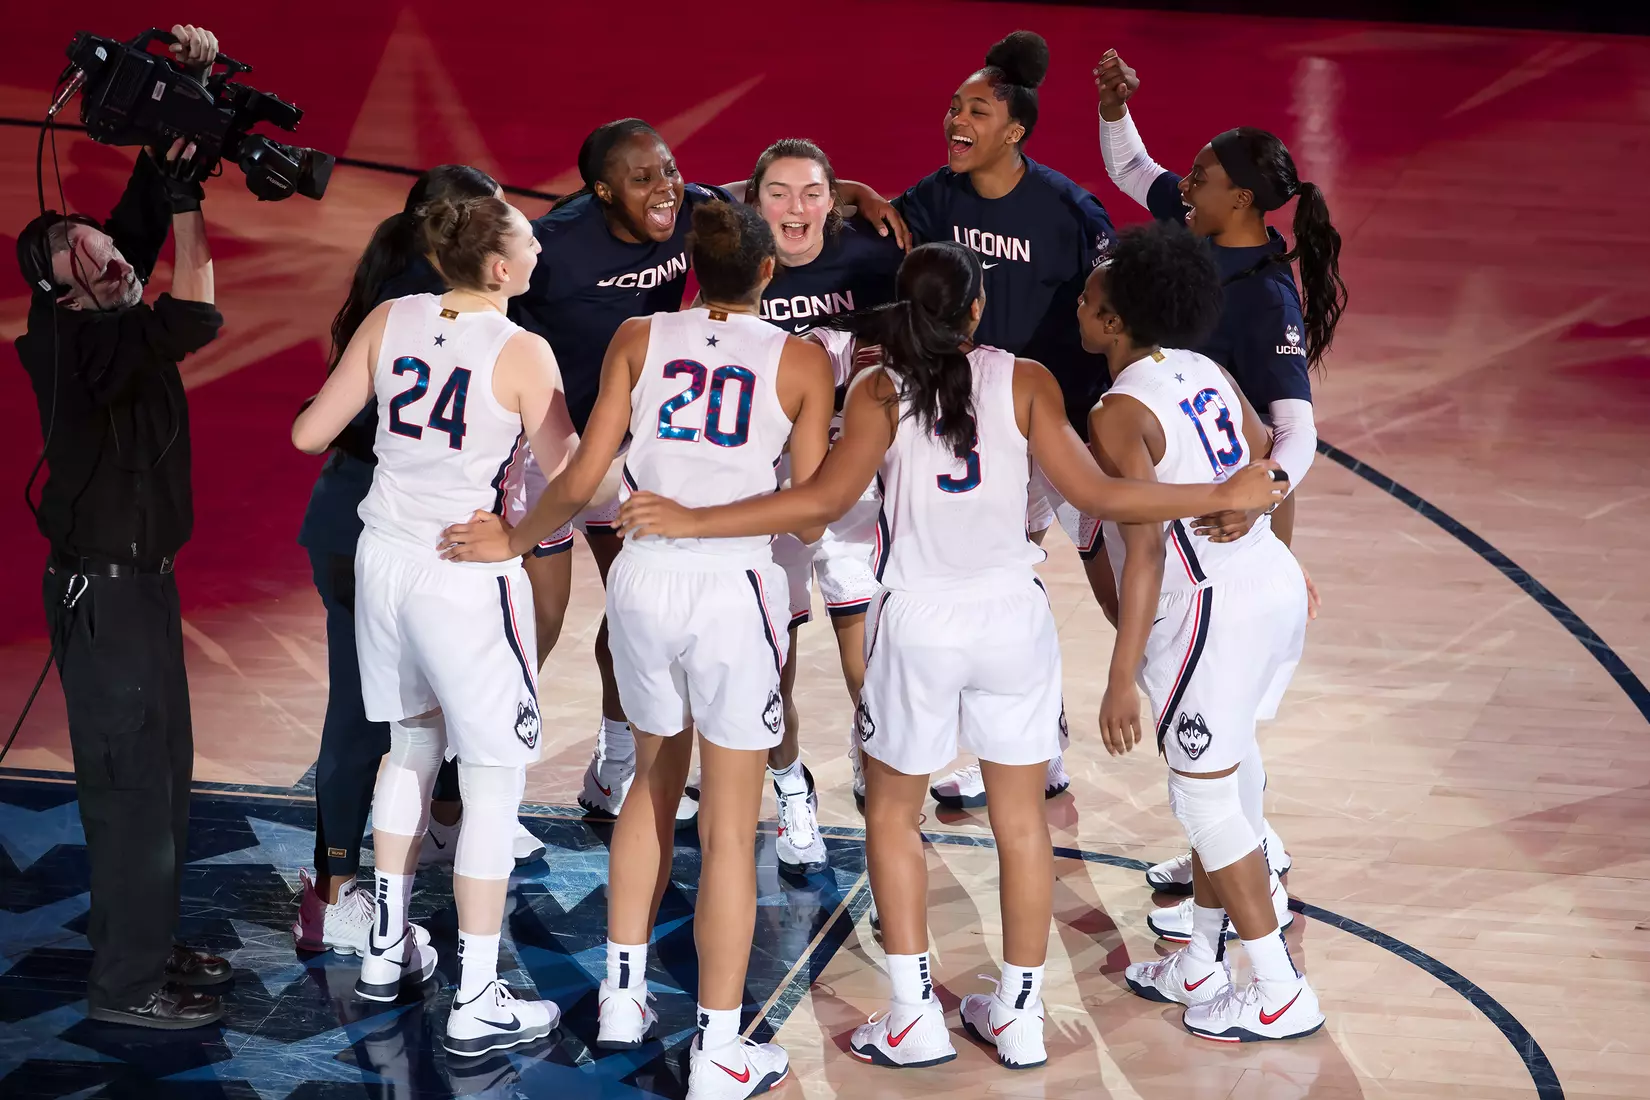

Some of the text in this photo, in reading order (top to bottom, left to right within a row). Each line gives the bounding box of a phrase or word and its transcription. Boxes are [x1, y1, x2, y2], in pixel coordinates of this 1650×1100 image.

[266, 175, 288, 190] FUJINON
[596, 251, 687, 289] UCONN
[953, 225, 1031, 263] UCONN
[389, 356, 472, 450] 24
[656, 359, 756, 448] 20
[1178, 388, 1243, 476] 13
[934, 414, 982, 493] 3
